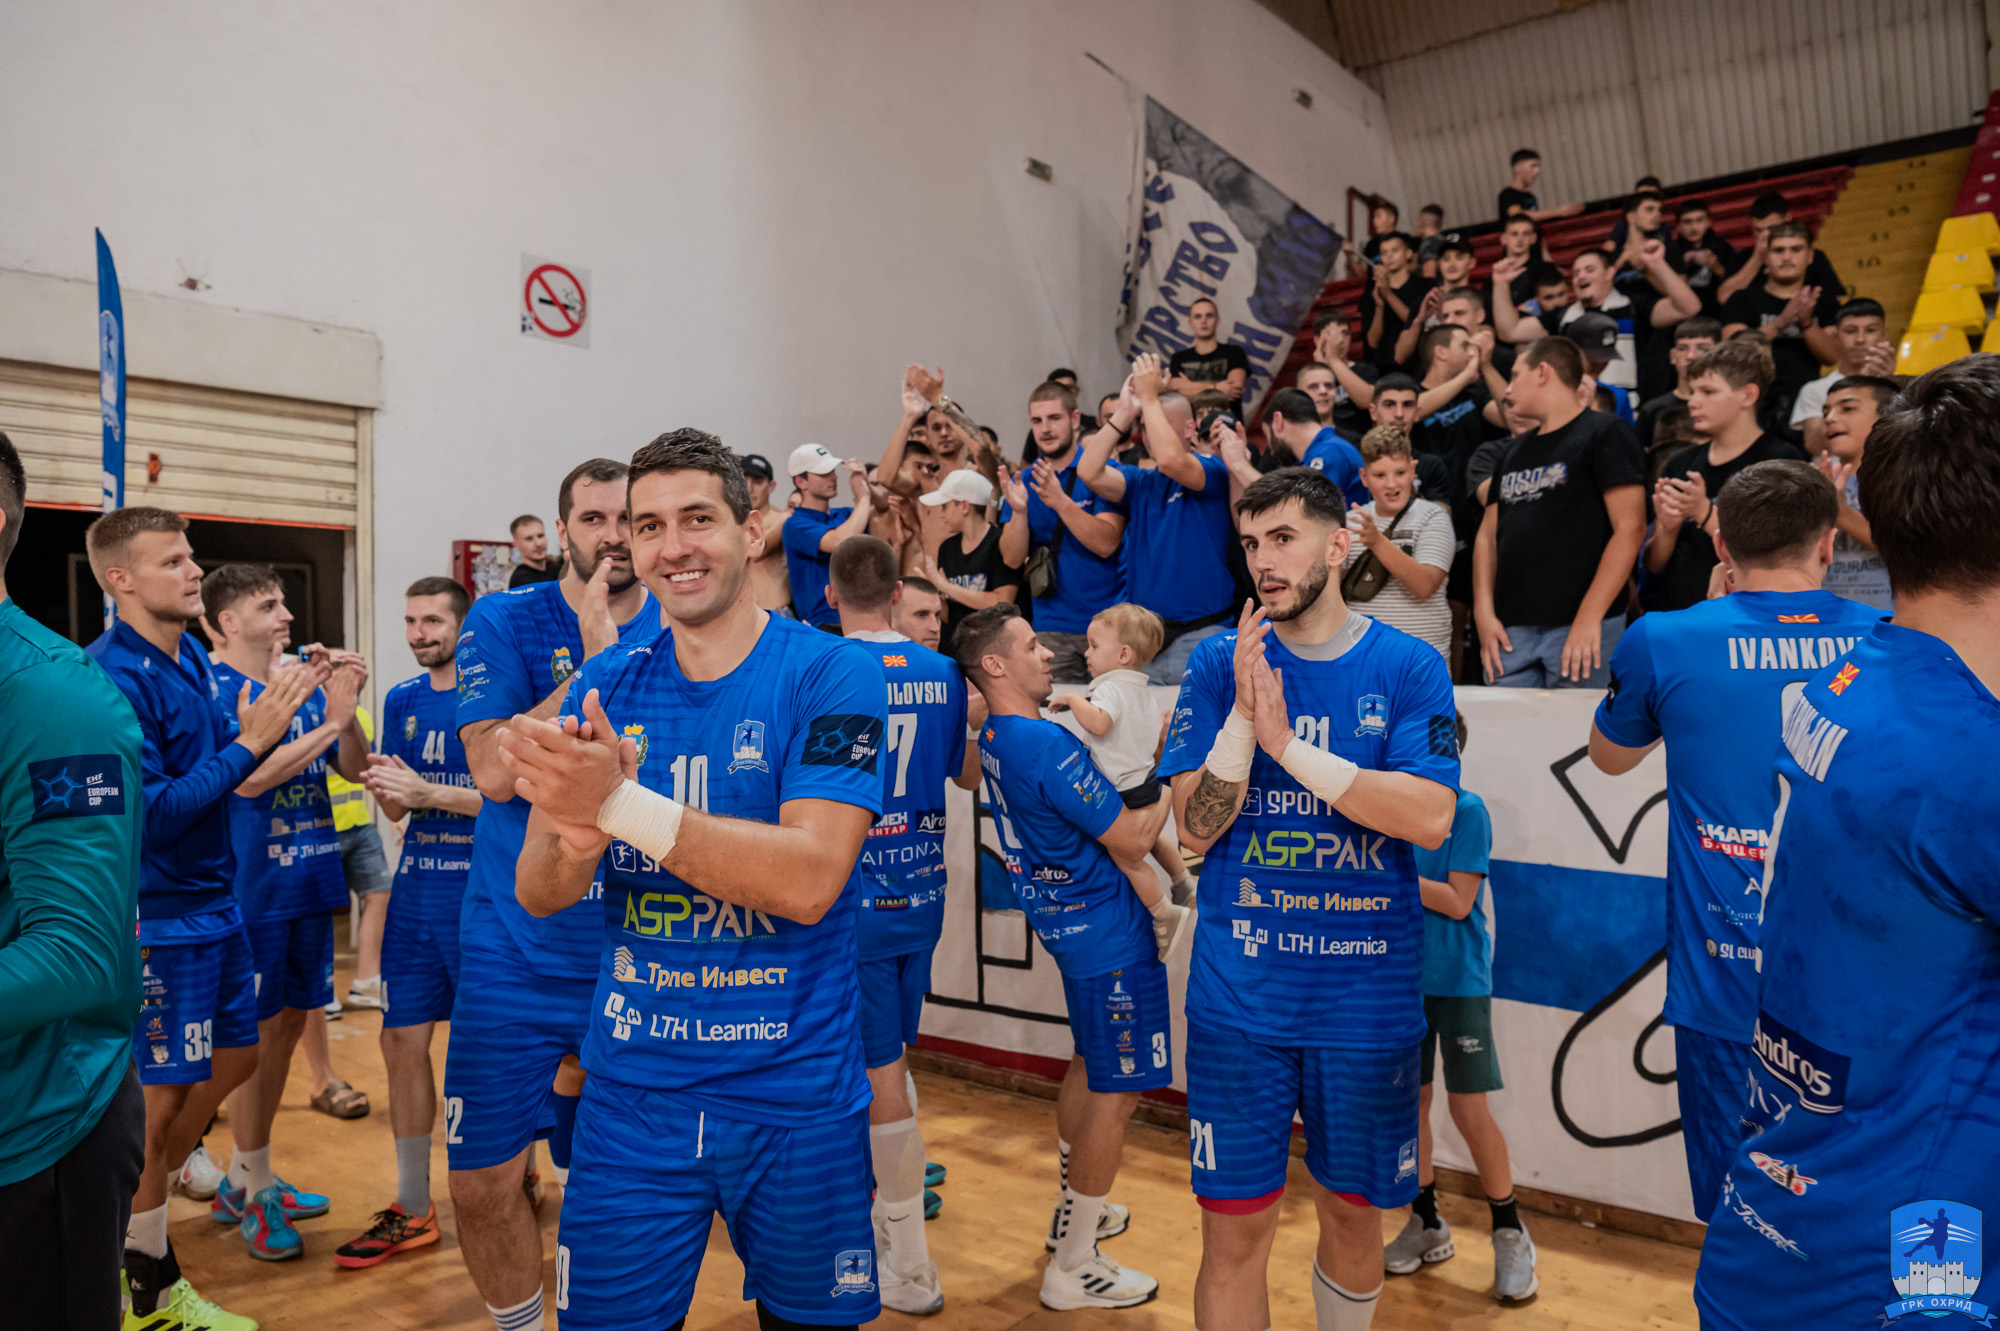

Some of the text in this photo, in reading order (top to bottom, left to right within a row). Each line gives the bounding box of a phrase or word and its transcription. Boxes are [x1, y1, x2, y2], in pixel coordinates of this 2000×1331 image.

[1728, 637, 1864, 670] IVANKOV
[422, 730, 446, 765] 44
[1295, 715, 1330, 752] 21
[887, 713, 918, 798] 7
[86, 772, 104, 784] EHF
[87, 787, 119, 797] EUROPEAN
[669, 754, 709, 814] 10
[89, 796, 102, 806] CUP
[1267, 790, 1333, 816] SPO
[440, 832, 474, 844] Инвес
[1706, 823, 1769, 846] КАРМ
[437, 858, 472, 871] Learni
[1241, 830, 1388, 871] ASPPAK
[1035, 866, 1069, 881] ndros
[622, 889, 777, 939] ASPPAK
[1271, 889, 1391, 913] Трпе Инвест
[1278, 932, 1387, 955] LTH Learnica
[1737, 946, 1757, 960] CLU
[647, 961, 788, 992] Трпе Инвест
[184, 1019, 212, 1062] 33
[650, 1014, 789, 1042] LTH Learnica
[1151, 1031, 1168, 1069] 3
[1753, 1017, 1832, 1097] Andros
[1190, 1118, 1217, 1171] 21
